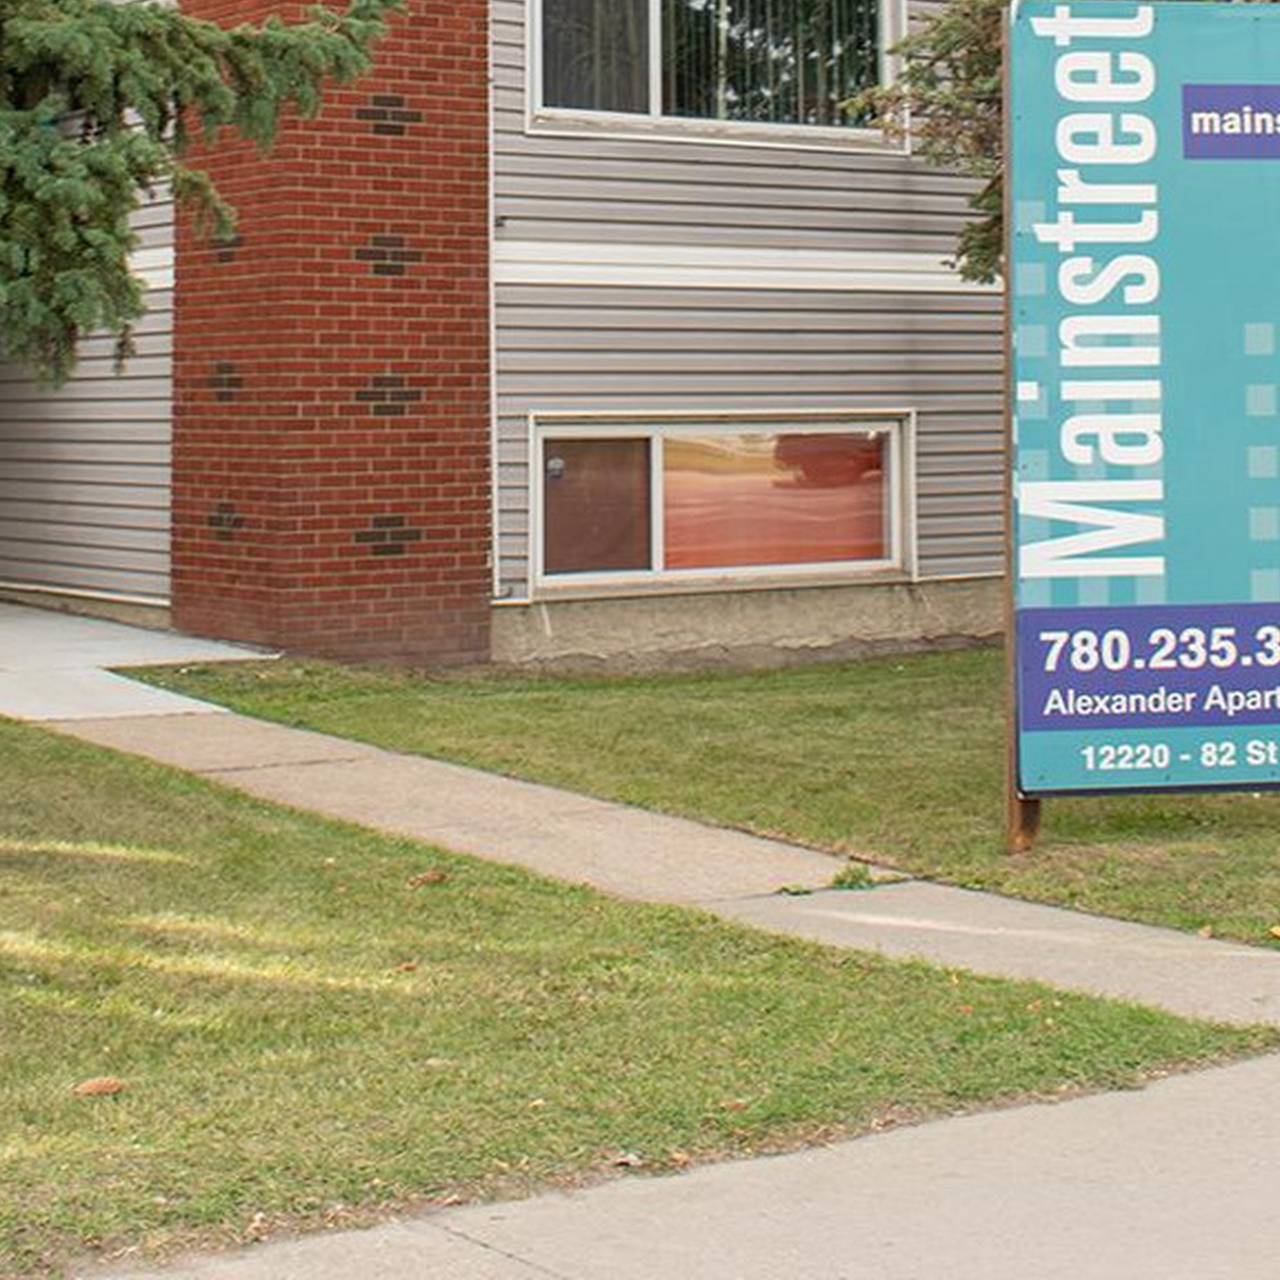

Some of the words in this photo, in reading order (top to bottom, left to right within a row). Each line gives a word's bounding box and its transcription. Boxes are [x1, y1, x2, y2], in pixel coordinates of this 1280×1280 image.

[1016, 5, 1166, 578] Mainstreet
[1043, 687, 1196, 716] Alexander
[1080, 744, 1170, 771] 12220
[1200, 742, 1236, 767] 82
[1246, 740, 1278, 765] St
